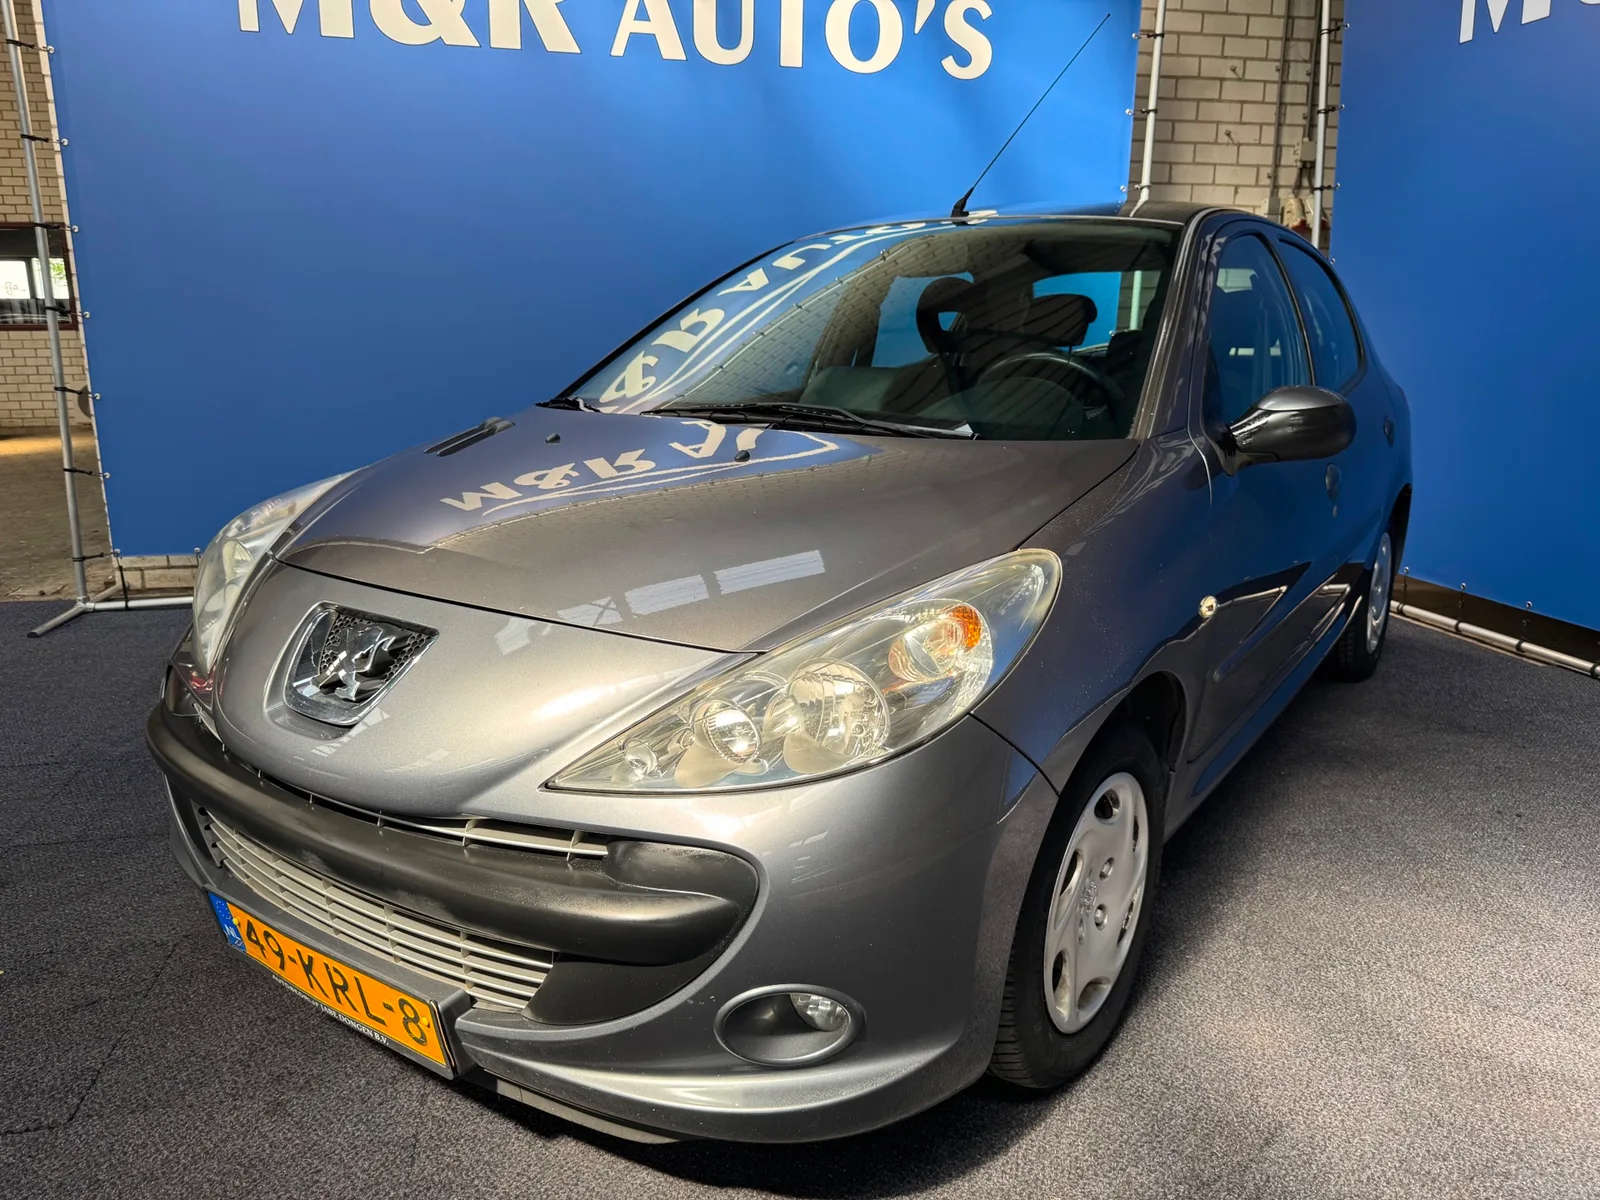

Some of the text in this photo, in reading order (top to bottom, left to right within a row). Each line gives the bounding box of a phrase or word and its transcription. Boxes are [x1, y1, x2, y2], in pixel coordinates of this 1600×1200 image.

[224, 923, 242, 941] NL
[245, 918, 428, 1047] 49-KRL-8
[338, 1012, 374, 1037] DONGEN
[373, 1031, 390, 1046] B.V.
